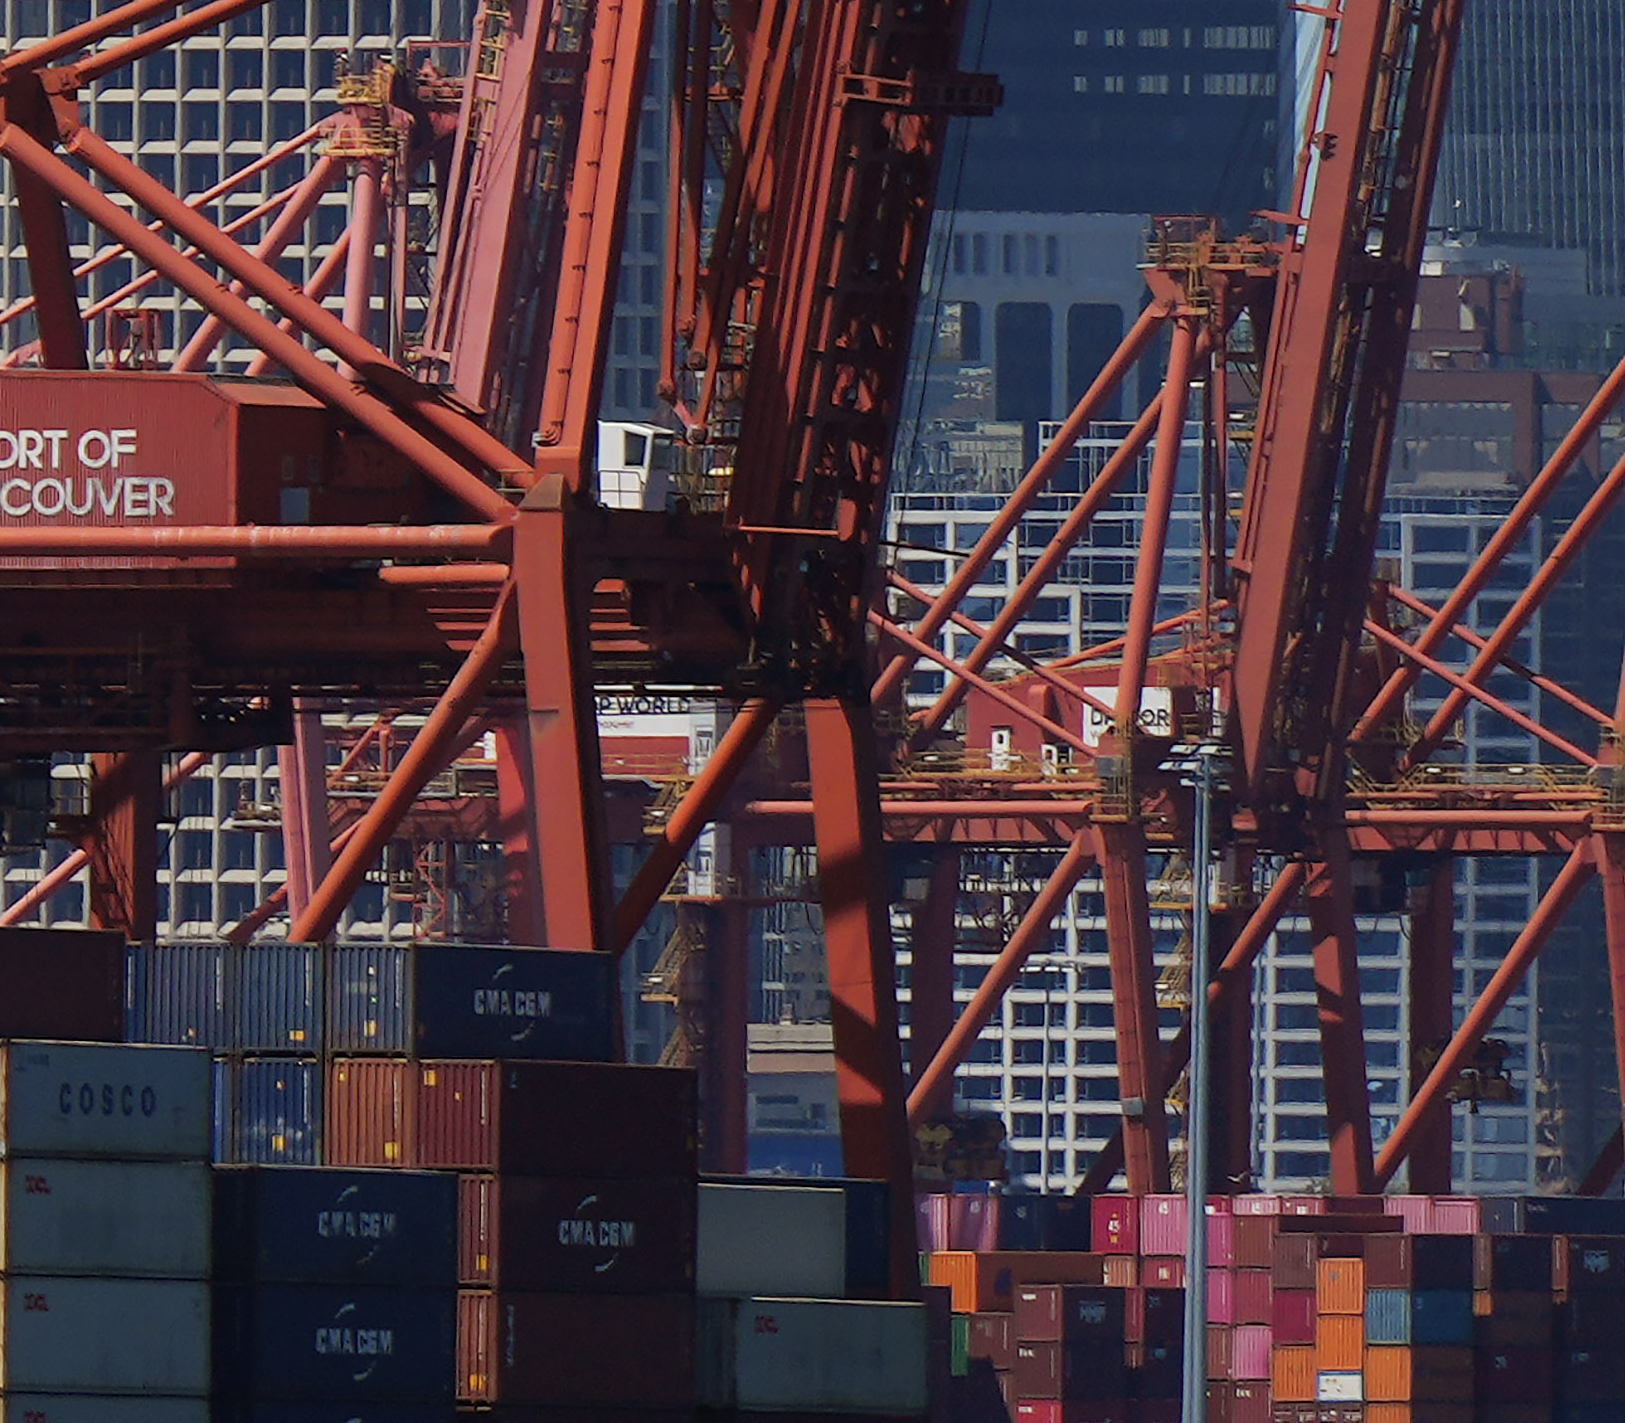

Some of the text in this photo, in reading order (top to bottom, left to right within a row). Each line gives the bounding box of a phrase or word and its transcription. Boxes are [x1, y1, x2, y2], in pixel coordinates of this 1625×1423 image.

[78, 429, 136, 469] OF
[474, 988, 551, 1017] CMA CGM
[59, 1083, 157, 1117] COSCO
[557, 1220, 636, 1247] CMA CGM
[316, 1327, 393, 1355] CMA CGM
